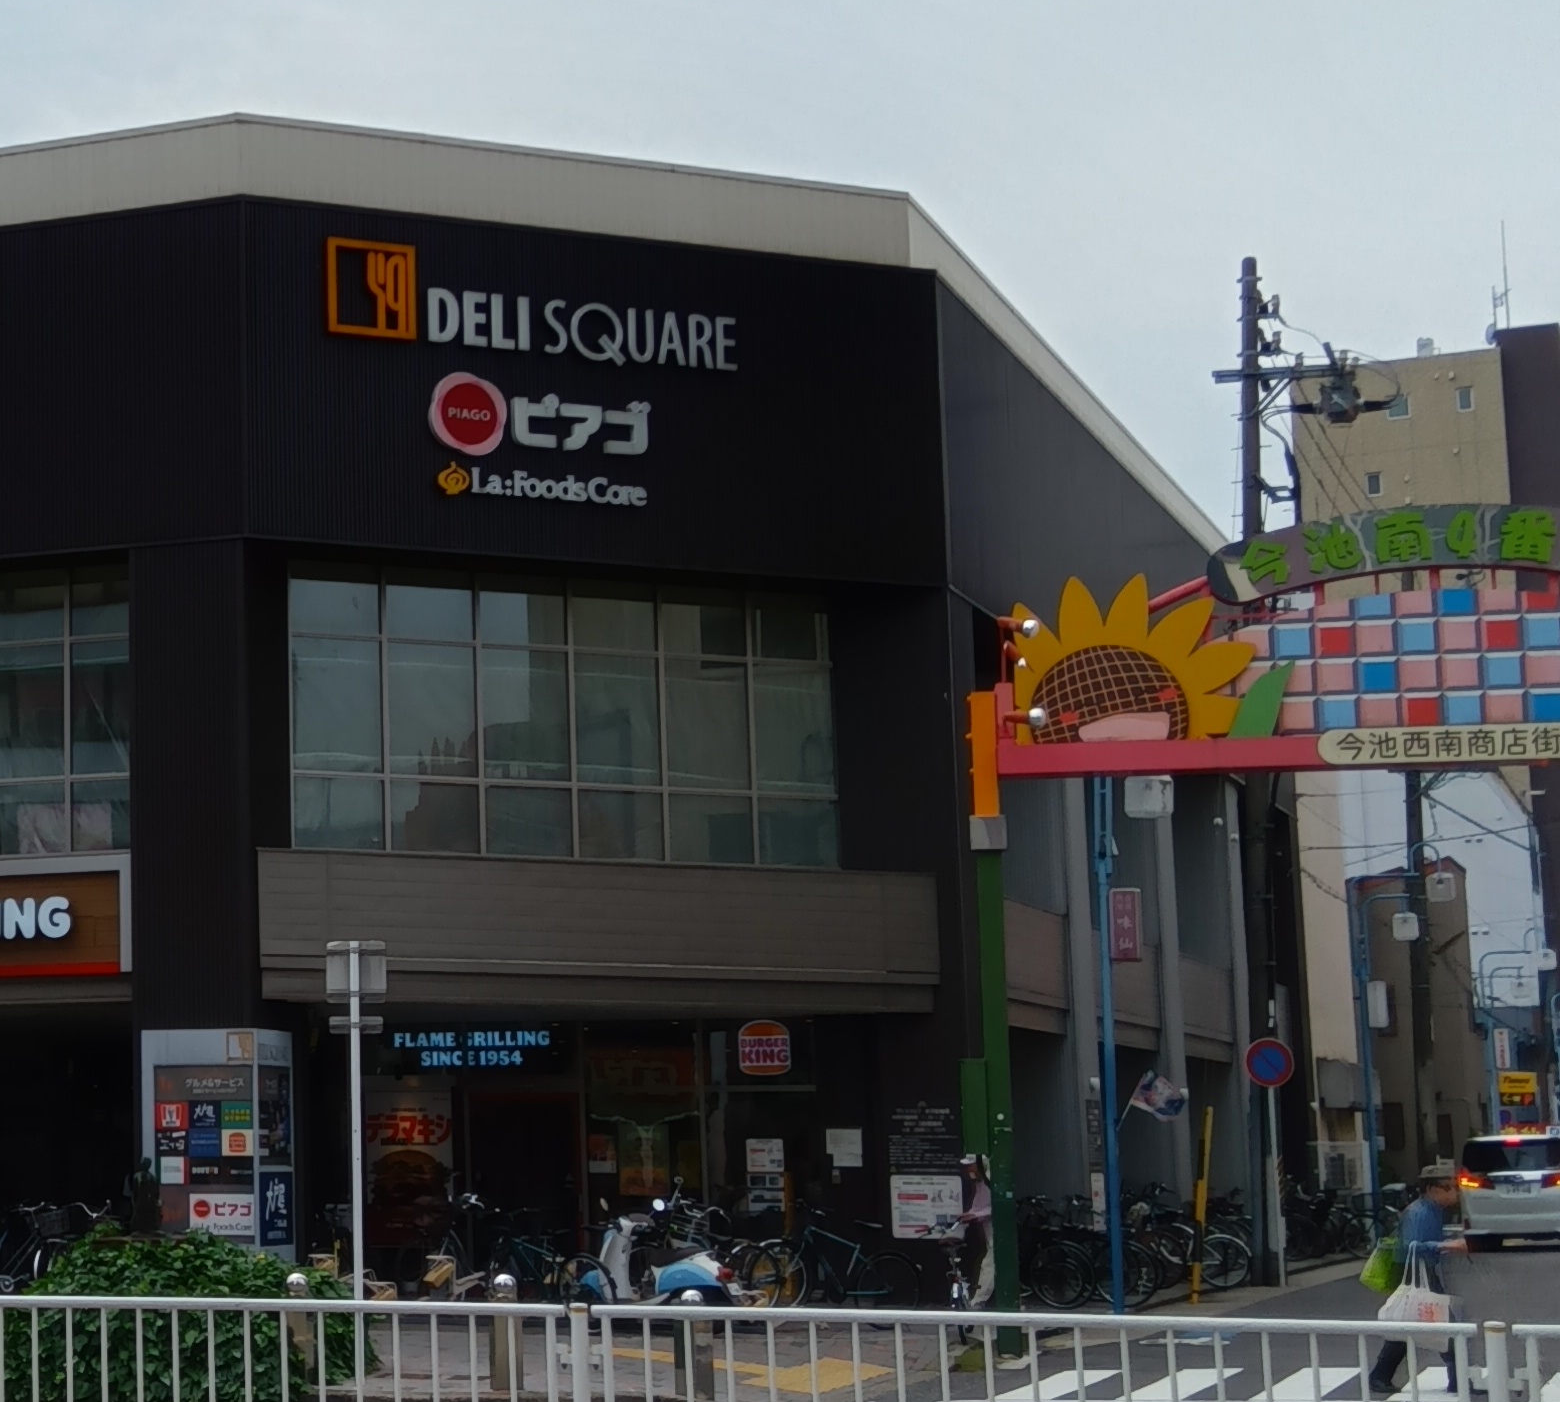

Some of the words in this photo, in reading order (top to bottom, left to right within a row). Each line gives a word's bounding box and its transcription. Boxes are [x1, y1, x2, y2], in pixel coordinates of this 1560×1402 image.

[427, 287, 530, 351] DELI
[544, 300, 738, 371] SQUARE
[447, 406, 491, 422] PIAGO
[511, 393, 651, 455] ピアゴ
[1336, 726, 1560, 761] 今池西南商店街
[393, 1032, 457, 1048] FLAME
[740, 1037, 788, 1048] BURGER
[420, 1051, 476, 1067] SINCE
[479, 1050, 523, 1066] 1954
[741, 1048, 789, 1064] KING
[214, 1201, 252, 1217] ピアゴ
